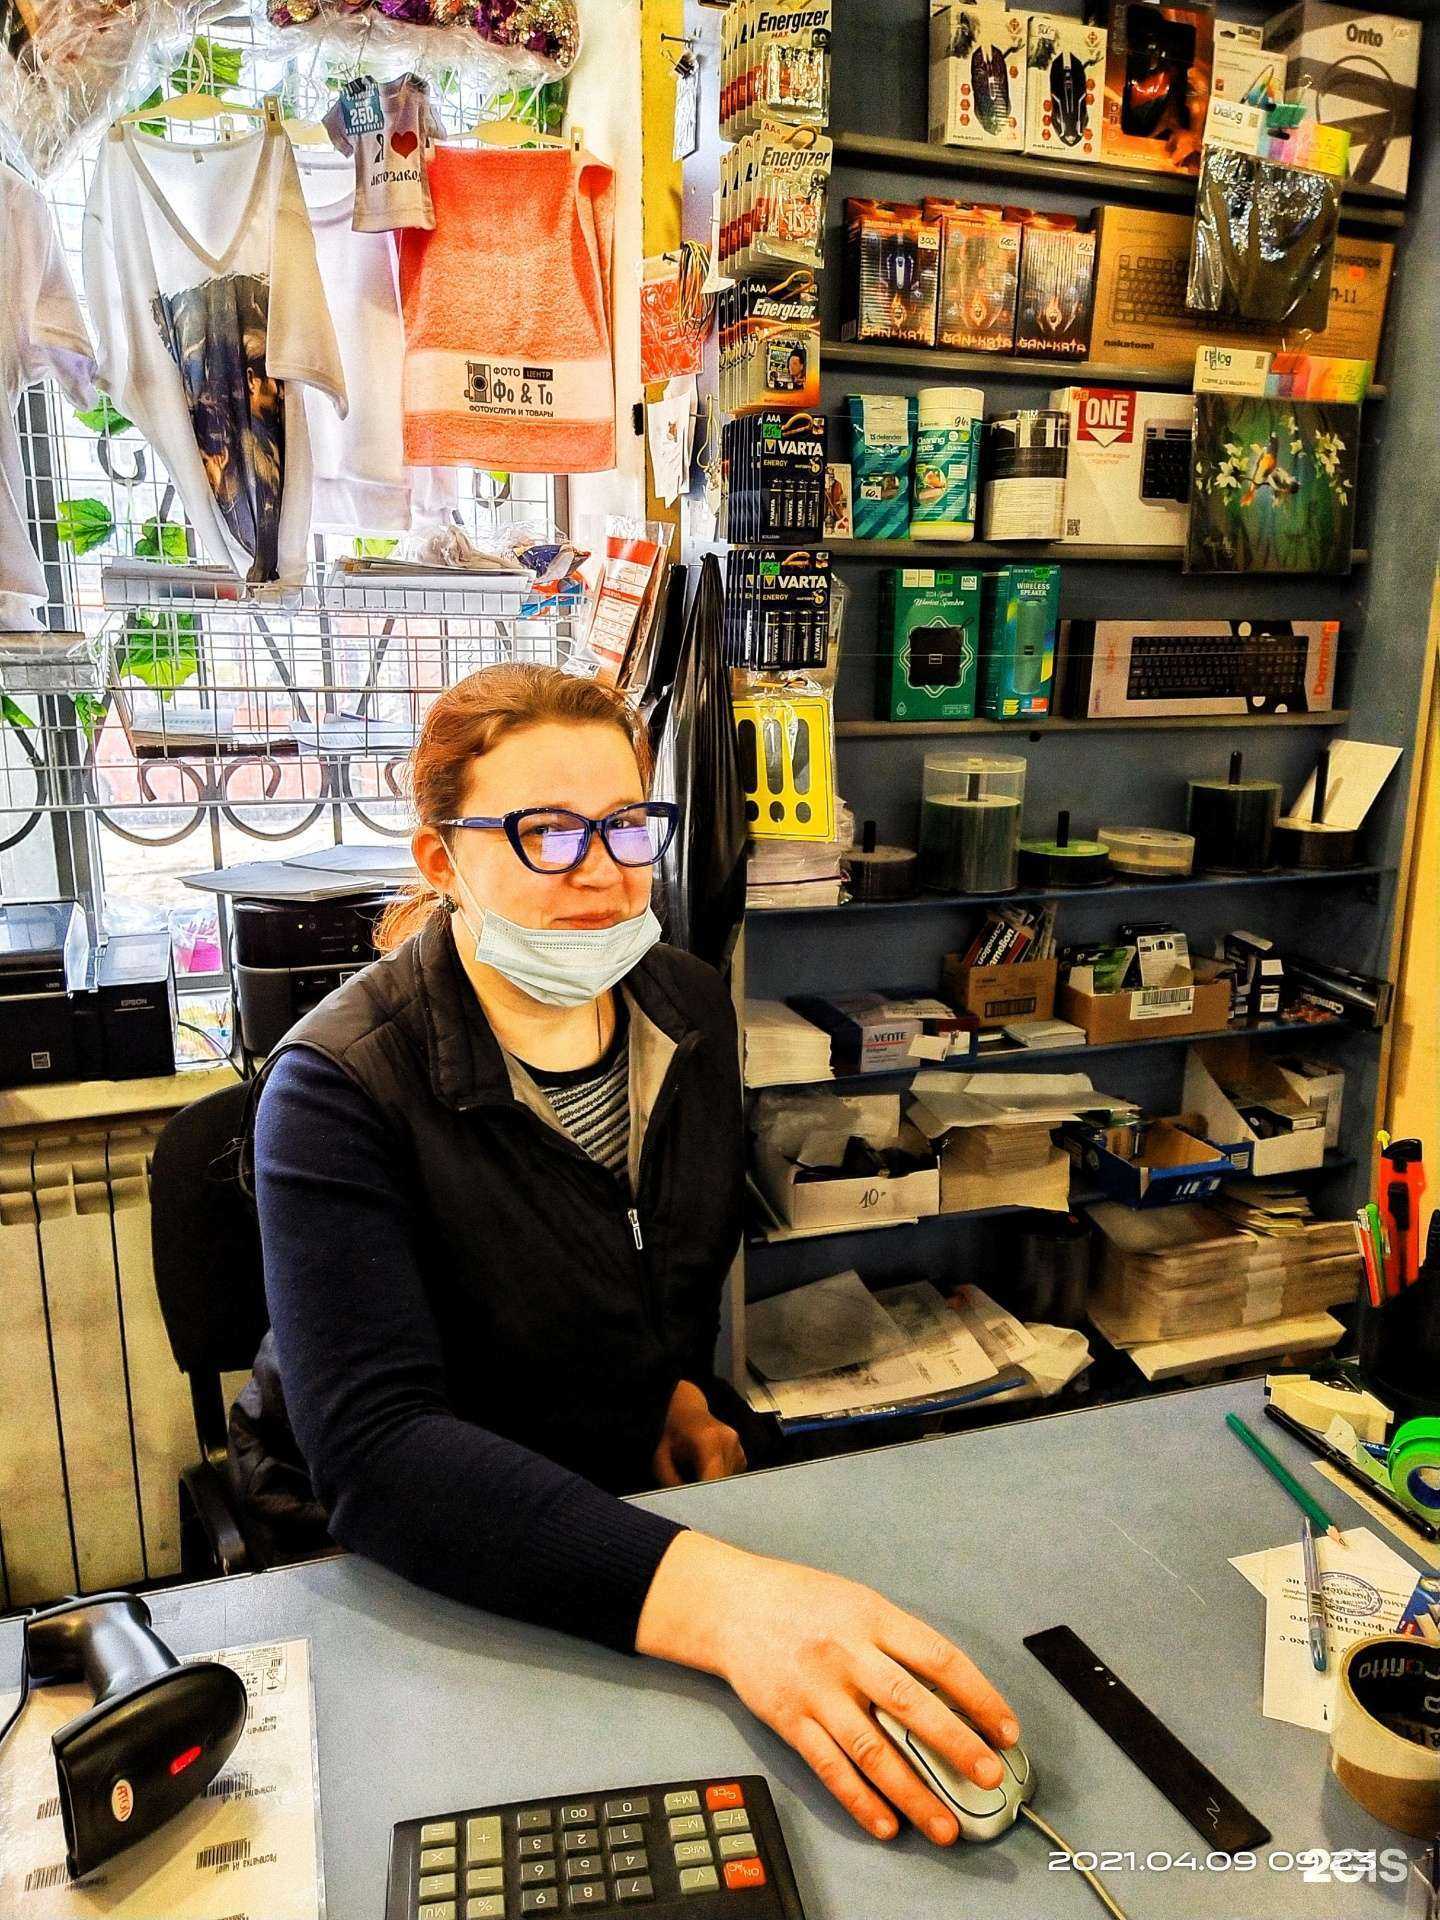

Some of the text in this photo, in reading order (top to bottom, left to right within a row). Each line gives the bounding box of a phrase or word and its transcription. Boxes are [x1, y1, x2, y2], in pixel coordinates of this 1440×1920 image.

[757, 9, 829, 33] Energizer
[1346, 23, 1383, 48] Onto
[374, 133, 384, 163] Я
[761, 146, 830, 171] Energizer
[750, 284, 767, 293] AAA
[1103, 339, 1155, 349] nakatomi
[493, 366, 551, 379] ФОТО ЦЕНТР
[493, 378, 515, 403] Фо
[537, 383, 553, 405] То
[469, 405, 517, 416] ФОТОУСЛУГИ
[525, 409, 554, 418] ТОВАРЫ
[1085, 397, 1128, 427] ONE
[766, 414, 781, 423] AAA
[778, 440, 823, 456] VARTA
[765, 552, 776, 560] AA
[778, 575, 828, 589] VARTA
[1016, 582, 1050, 590] WIRELESS
[622, 1802, 632, 1812] 0
[570, 1808, 587, 1819] 00
[577, 1833, 587, 1845] 2
[622, 1828, 630, 1839] 1
[532, 1838, 542, 1850] 3
[682, 1845, 706, 1856] MRC
[625, 1855, 635, 1866] 4
[534, 1864, 544, 1876] 6
[583, 1886, 593, 1898] 8
[631, 1881, 640, 1894] 7
[535, 1892, 546, 1904] 9
[425, 1906, 446, 1920] MU
